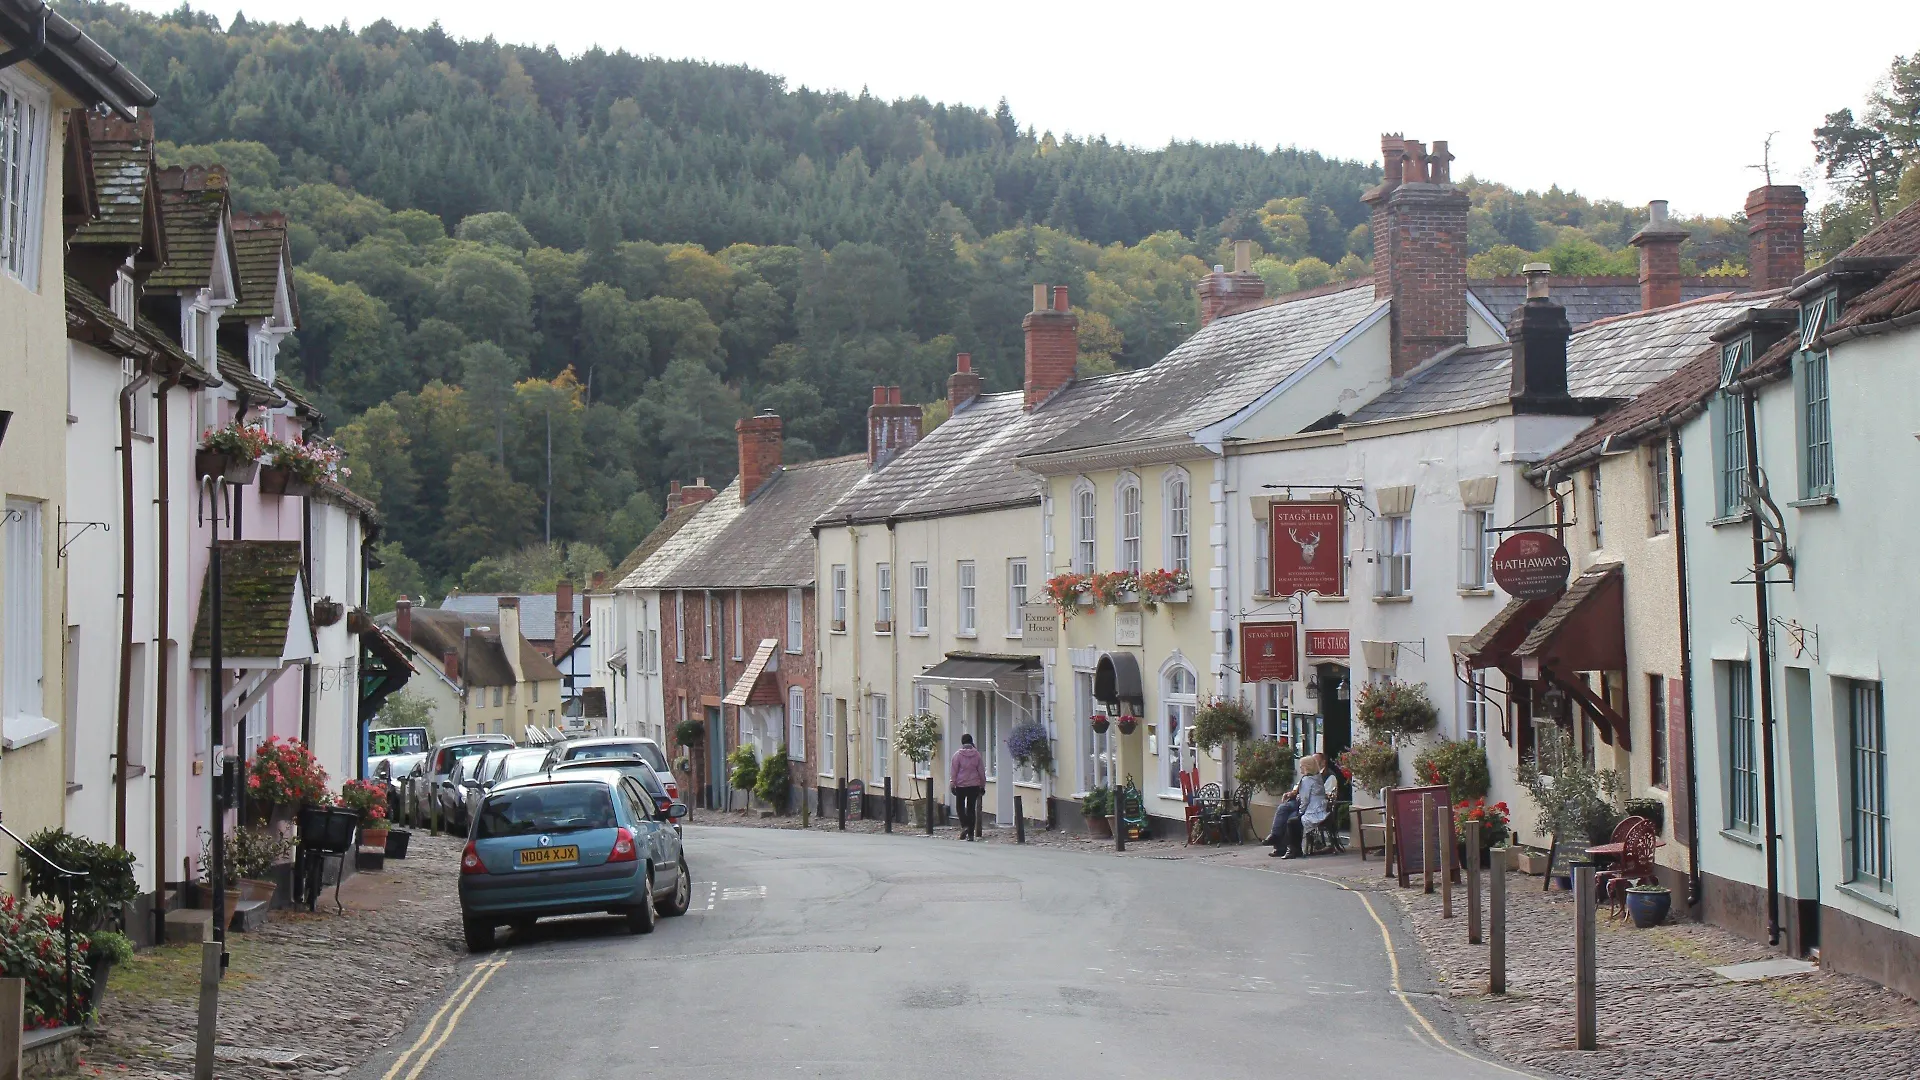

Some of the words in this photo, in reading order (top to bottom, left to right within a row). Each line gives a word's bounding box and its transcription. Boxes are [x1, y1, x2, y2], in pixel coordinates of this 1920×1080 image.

[1278, 513, 1306, 521] STAGS
[1309, 513, 1333, 521] HEAD
[1495, 556, 1568, 570] HATHAWAY'S
[1025, 612, 1056, 621] Exmoor
[1028, 623, 1053, 632] House
[1313, 637, 1326, 650] THE
[1327, 636, 1348, 650] STAGS
[521, 850, 550, 862] ND04
[553, 848, 575, 860] XJX
